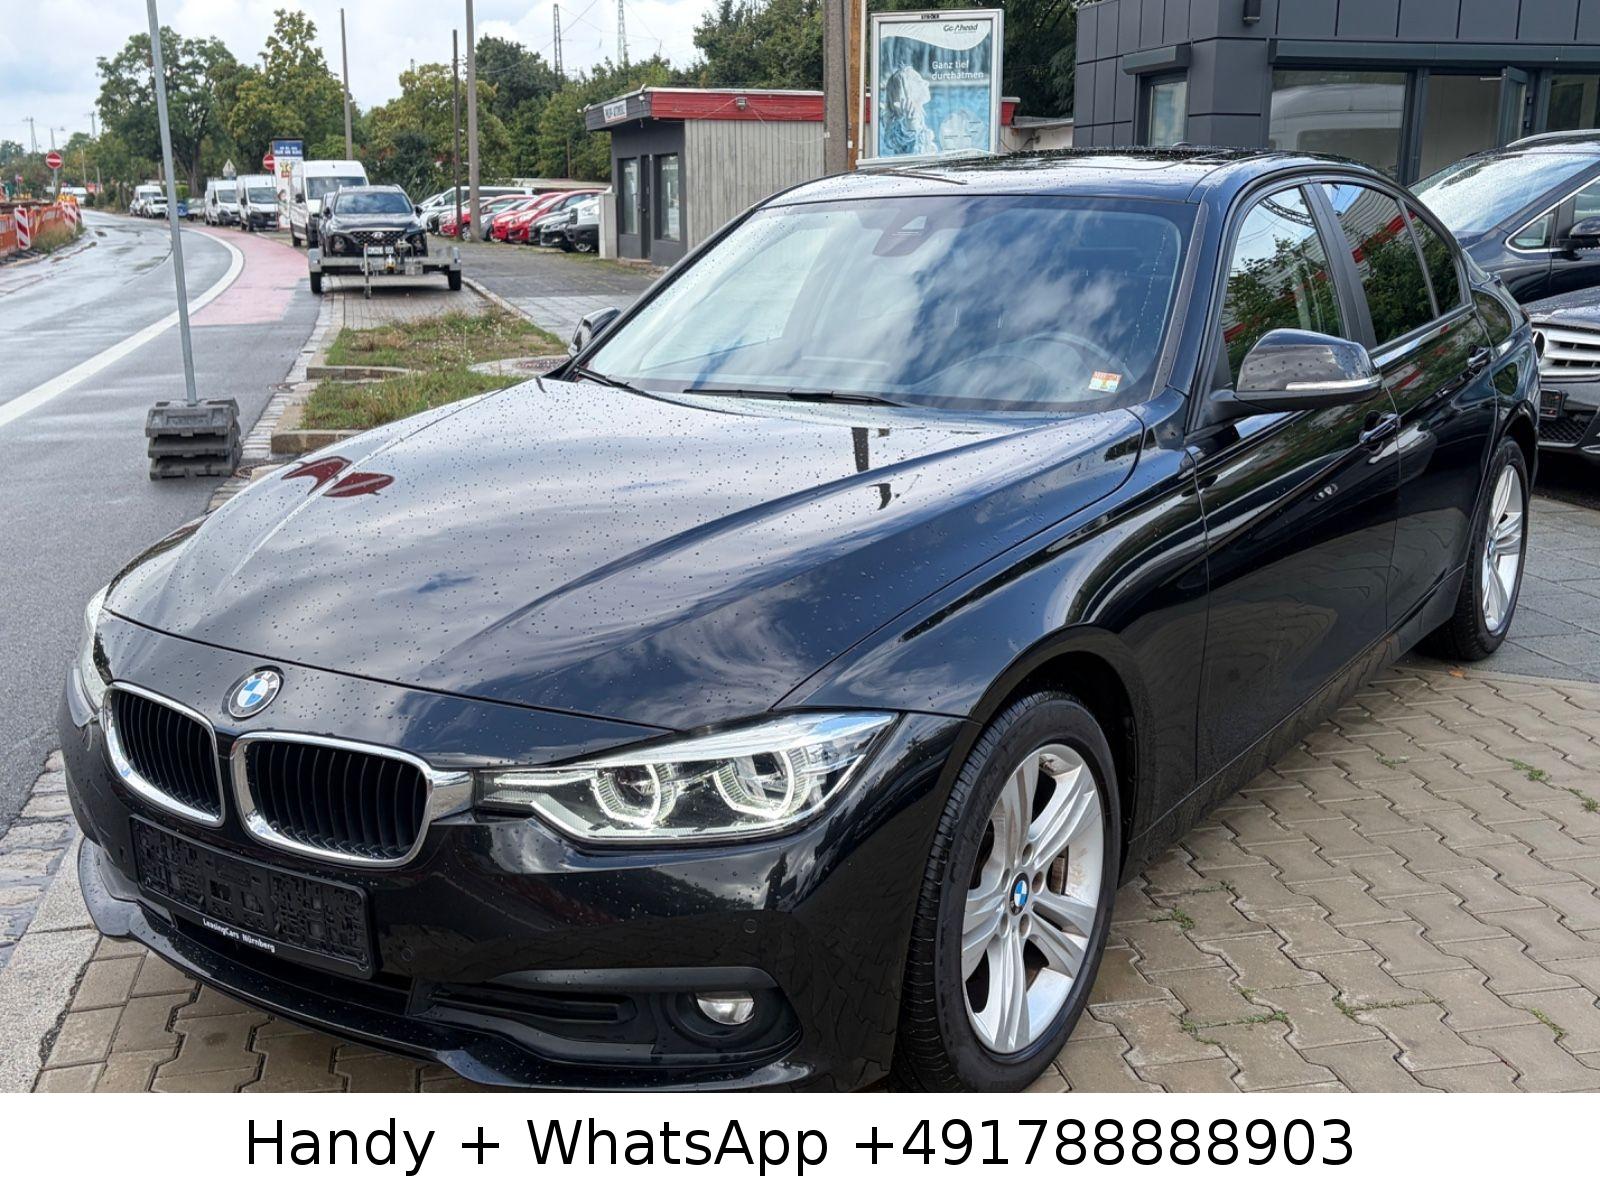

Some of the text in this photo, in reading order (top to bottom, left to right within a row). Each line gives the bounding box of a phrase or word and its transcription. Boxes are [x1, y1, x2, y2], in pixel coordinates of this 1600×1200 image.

[931, 59, 969, 70] Ganz tief
[931, 71, 984, 81] durchatmen
[242, 933, 276, 954] Nürnberg
